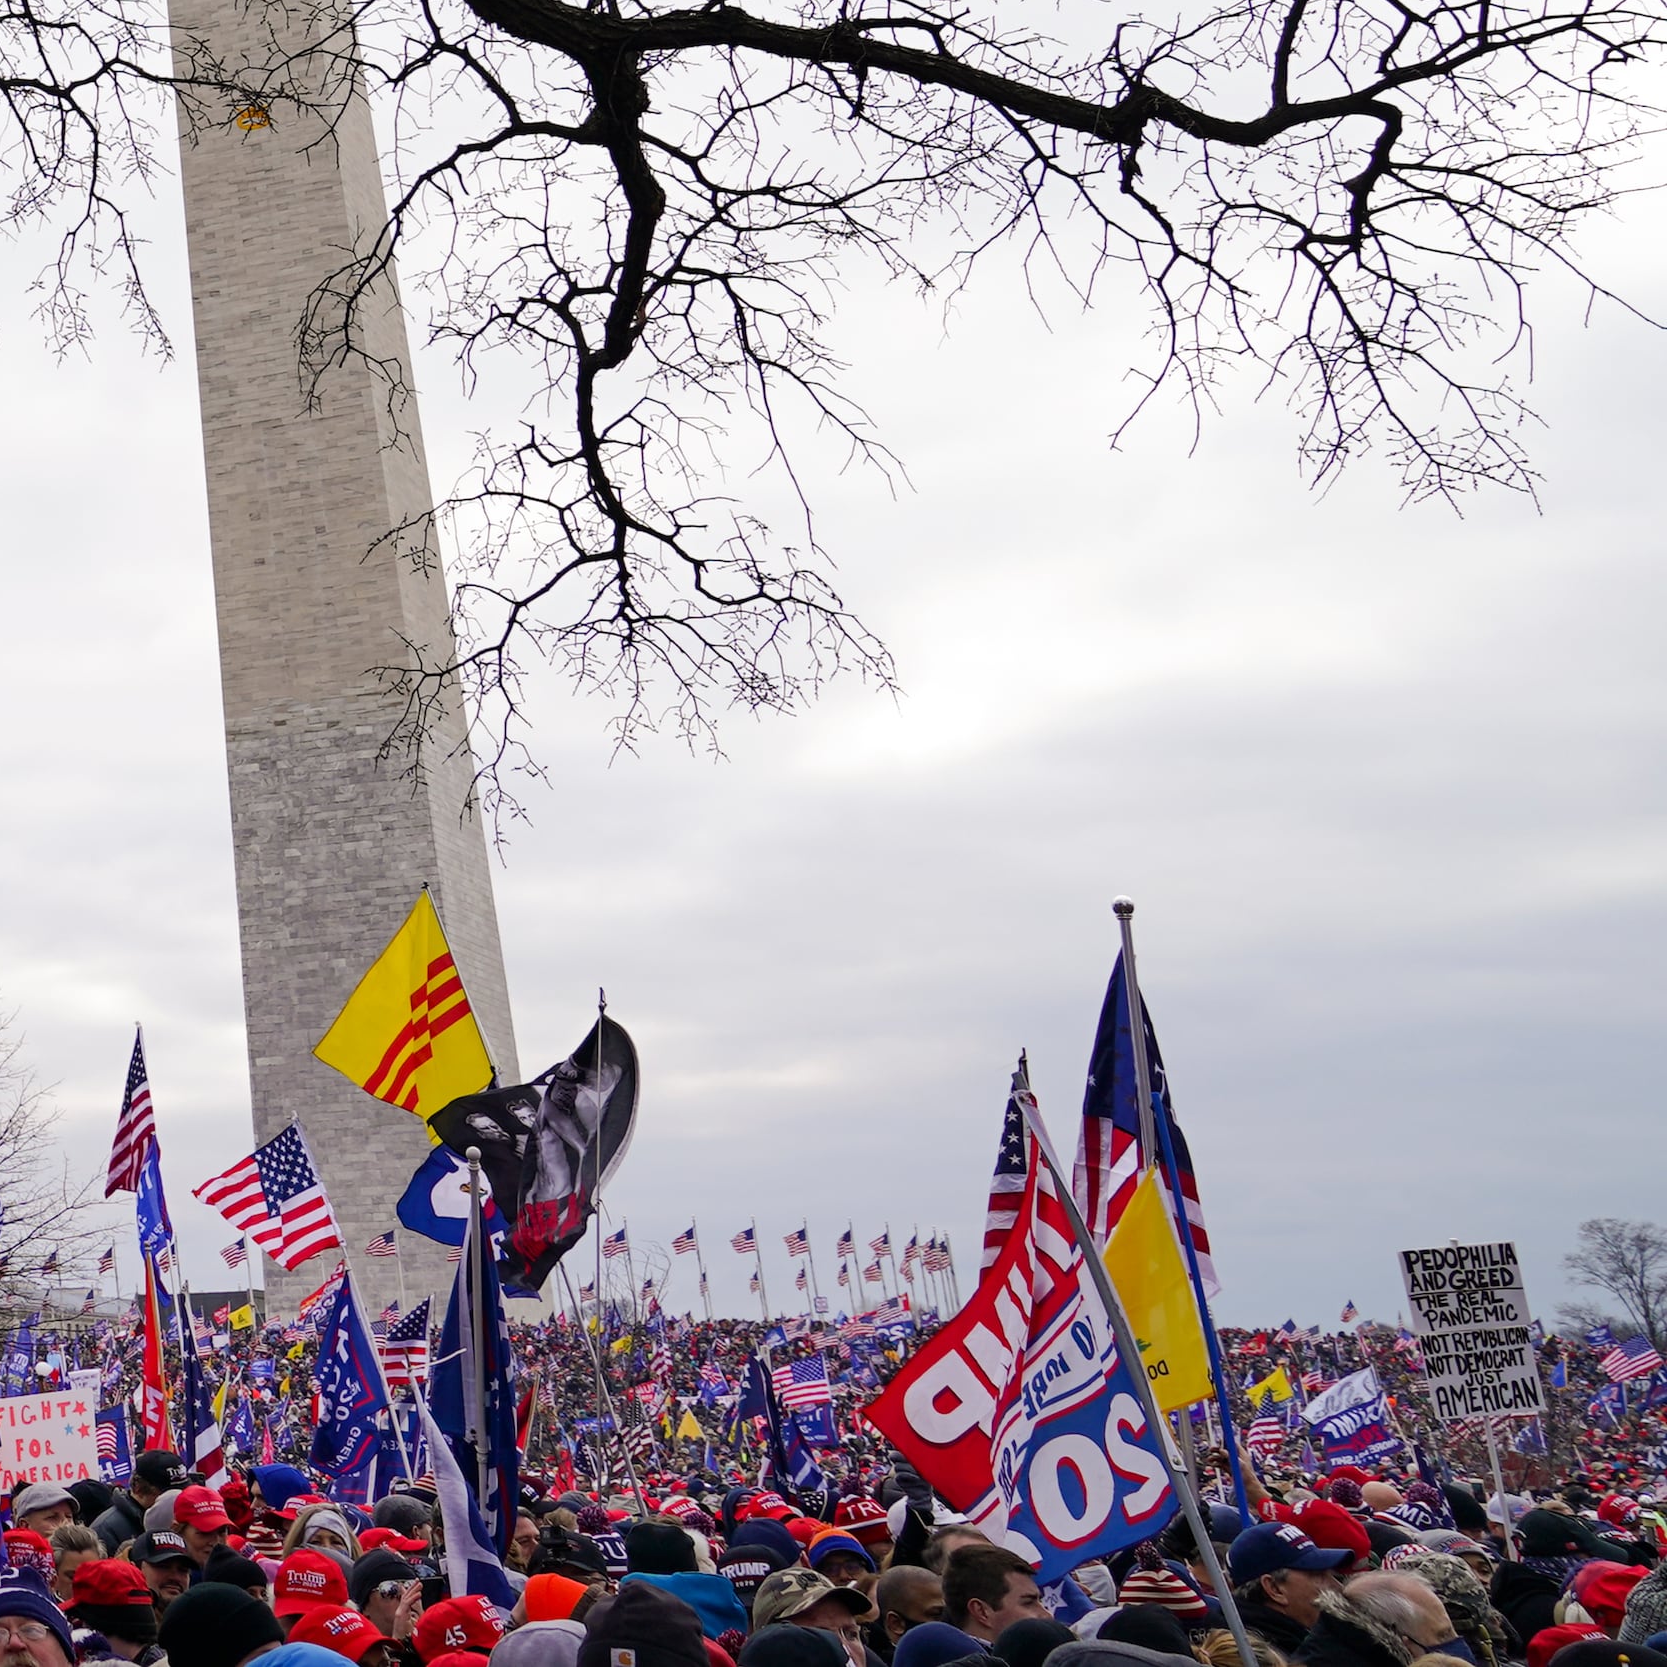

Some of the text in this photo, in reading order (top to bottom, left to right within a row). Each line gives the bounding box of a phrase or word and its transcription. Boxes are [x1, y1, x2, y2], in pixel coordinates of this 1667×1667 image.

[1403, 1242, 1518, 1274] PEDOPHILIA
[1410, 1267, 1515, 1293] AND GREED
[1410, 1290, 1504, 1312] THE REAL
[1423, 1304, 1518, 1332] PANDEMIC
[1420, 1327, 1531, 1356] NOT REPUBLICAN
[1425, 1347, 1525, 1379] NOT DEMOCRAT
[1465, 1369, 1504, 1387] JUST
[1435, 1376, 1540, 1418] AMERICAN
[15, 1438, 54, 1462] FOR
[2, 1462, 89, 1490] AMERICA
[287, 1569, 327, 1588] Trump
[719, 1561, 771, 1580] TRUMP
[444, 1623, 467, 1647] 45
